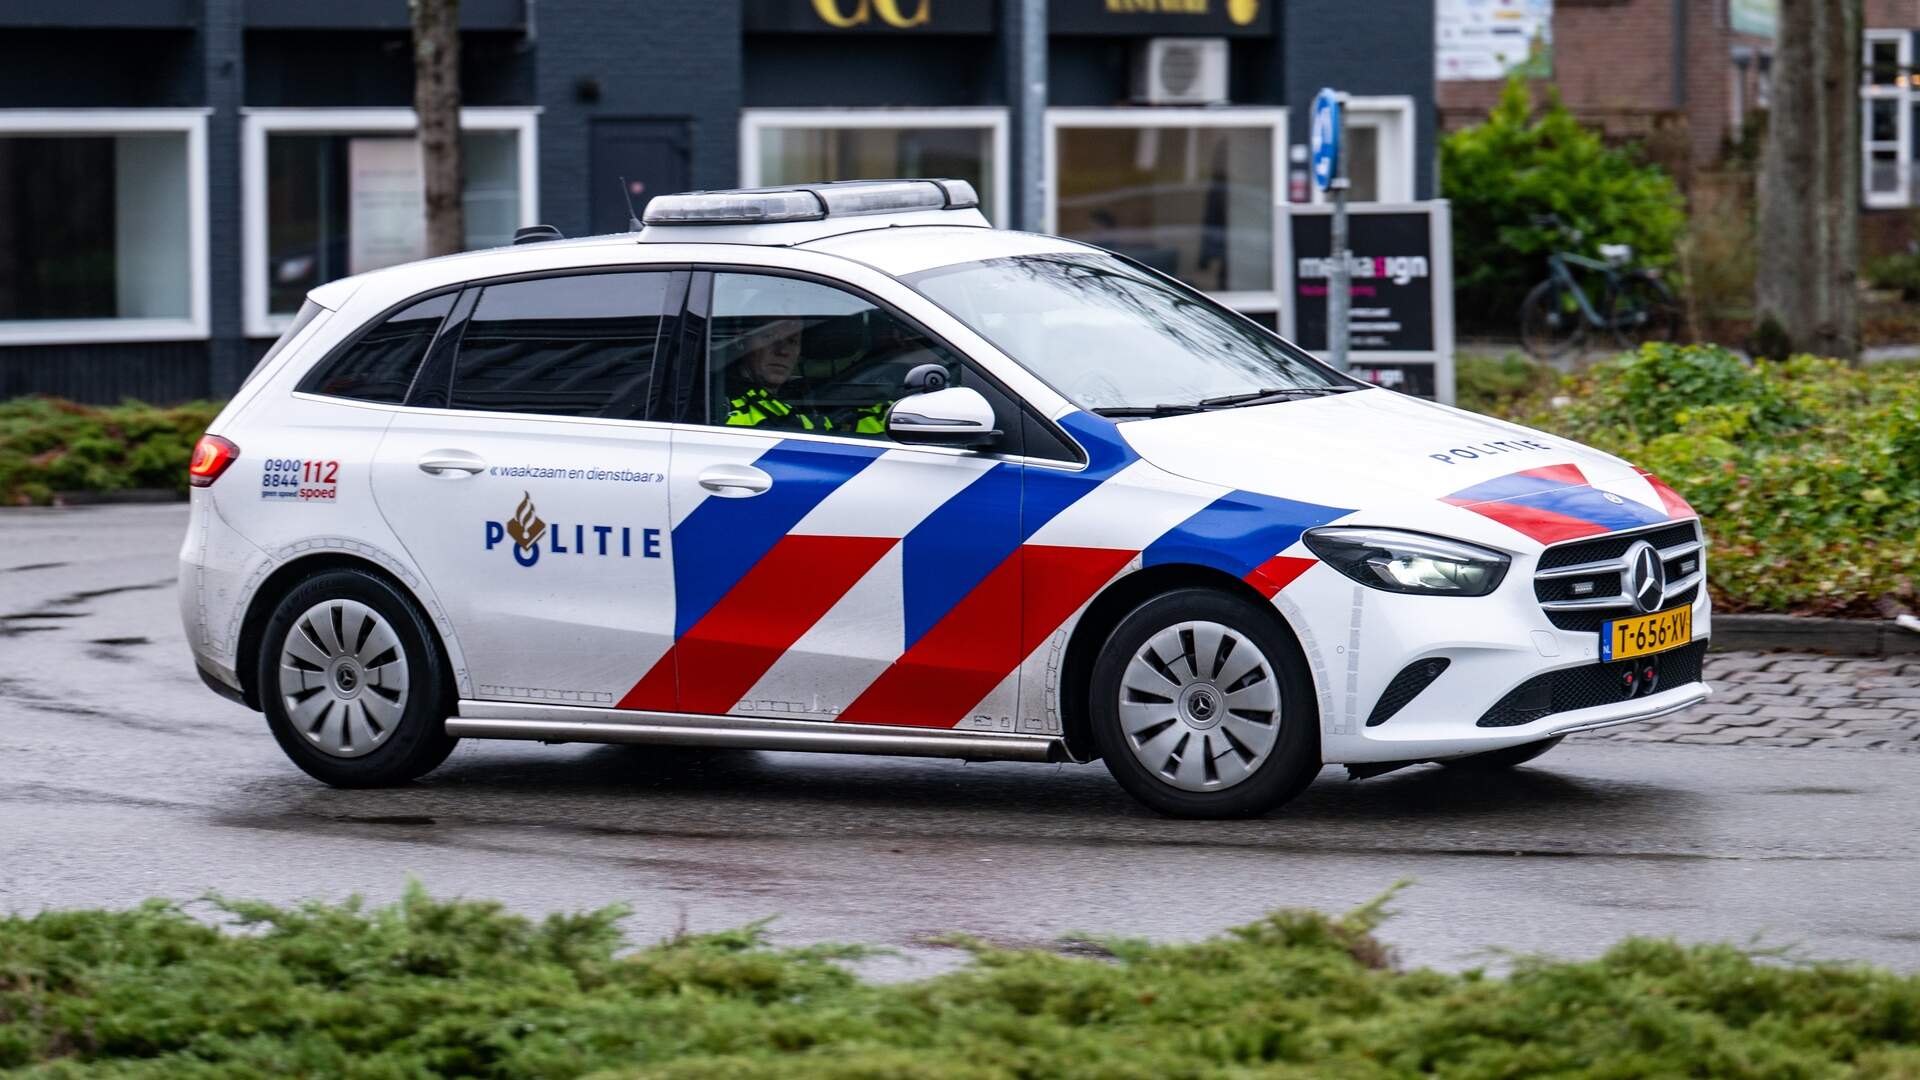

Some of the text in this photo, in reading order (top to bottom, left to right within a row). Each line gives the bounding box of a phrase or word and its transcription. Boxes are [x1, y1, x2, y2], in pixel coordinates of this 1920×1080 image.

[1429, 440, 1552, 465] POLITIE
[264, 458, 301, 472] 0900
[303, 461, 339, 483] 112
[500, 464, 567, 478] waakzaam
[568, 468, 584, 480] en
[586, 467, 654, 483] dienstbaar
[262, 473, 298, 487] 8844
[299, 485, 336, 501] spoed
[485, 520, 661, 567] POLITIE
[1618, 611, 1688, 653] T-656-XV
